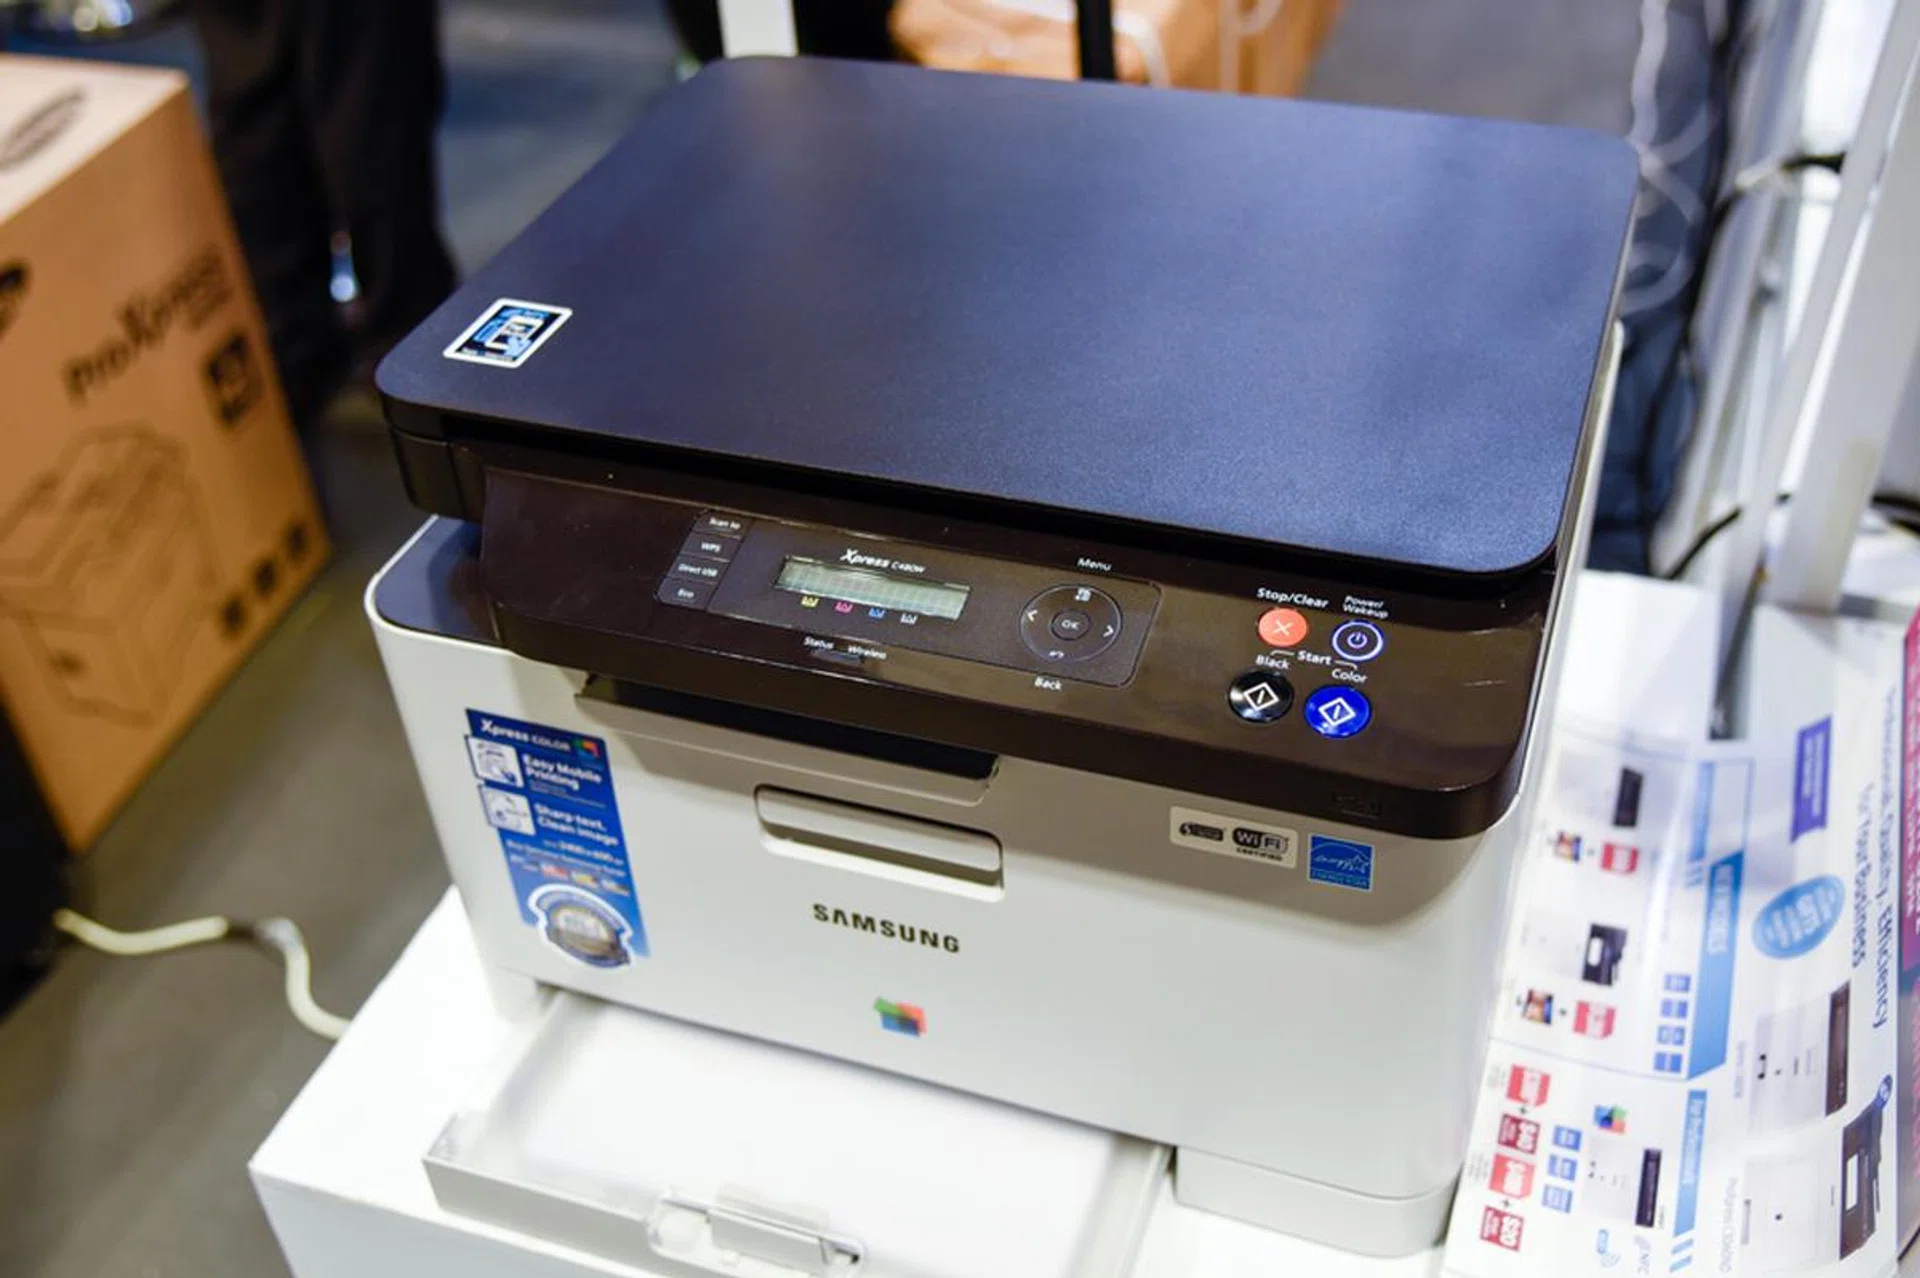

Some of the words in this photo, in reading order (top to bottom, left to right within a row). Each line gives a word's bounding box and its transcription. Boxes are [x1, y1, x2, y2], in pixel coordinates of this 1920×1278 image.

[709, 517, 729, 527] Scan
[730, 521, 741, 530] to
[701, 541, 721, 553] WPS
[840, 548, 890, 568] Xpress
[1077, 557, 1113, 571] Menu
[679, 563, 701, 575] Direct
[702, 567, 718, 578] USB
[1257, 587, 1329, 608] Stop/Clear
[1344, 595, 1384, 608] Power/
[1342, 603, 1389, 619] Wakeup
[1061, 618, 1080, 630] OK
[803, 636, 834, 650] Status
[847, 645, 887, 660] Wireless
[1297, 649, 1332, 666] Start
[1255, 654, 1290, 670] Black
[1034, 676, 1063, 691] Back
[1331, 668, 1367, 683] Color
[481, 719, 530, 742] Xpress
[530, 733, 572, 751] COLOR
[523, 754, 555, 772] Easy
[557, 760, 602, 784] Mobile
[524, 766, 580, 791] Printing
[537, 815, 577, 833] Clean
[1851, 862, 1871, 969] Business
[813, 903, 960, 953] SAMSUNG
[1872, 902, 1893, 1028] Efficiency
